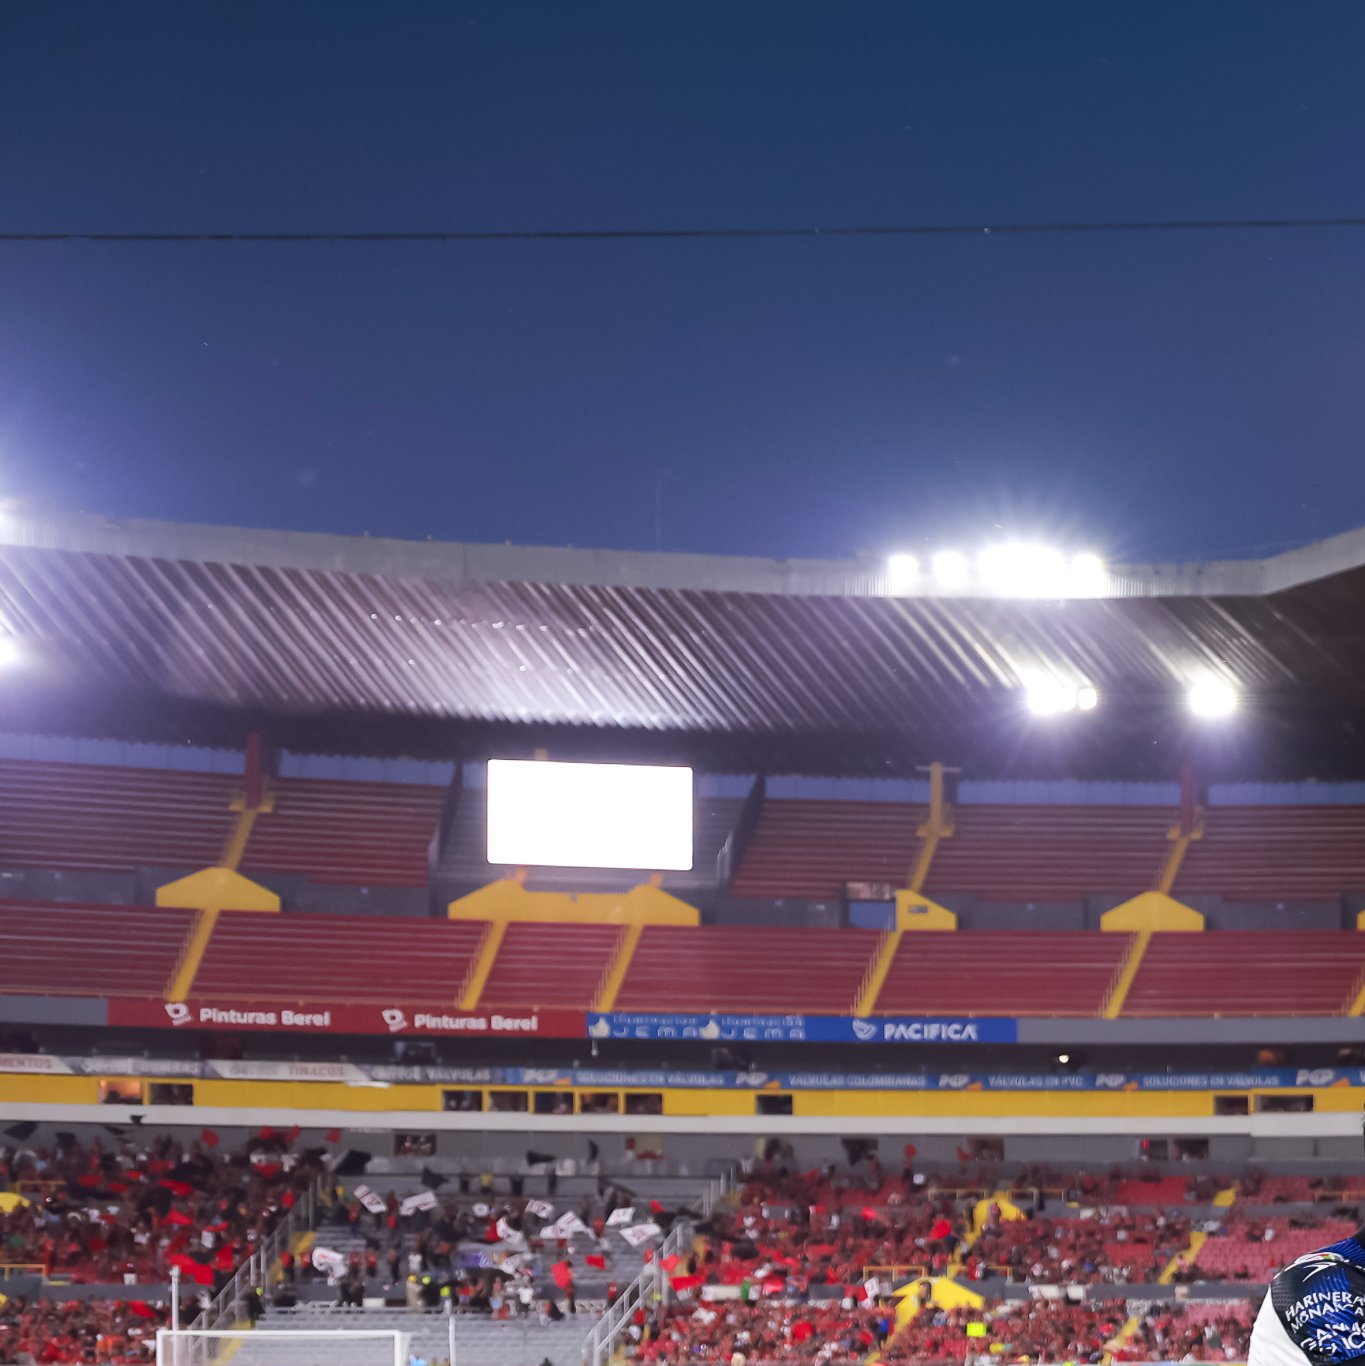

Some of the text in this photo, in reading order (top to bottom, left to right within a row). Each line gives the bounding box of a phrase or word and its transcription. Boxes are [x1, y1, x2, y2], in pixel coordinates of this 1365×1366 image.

[199, 1007, 277, 1025] Pinturas
[281, 1010, 331, 1026] Berel
[414, 1014, 487, 1030] Pinturas
[490, 1015, 538, 1031] Berel
[884, 1023, 978, 1040] PACIFICA
